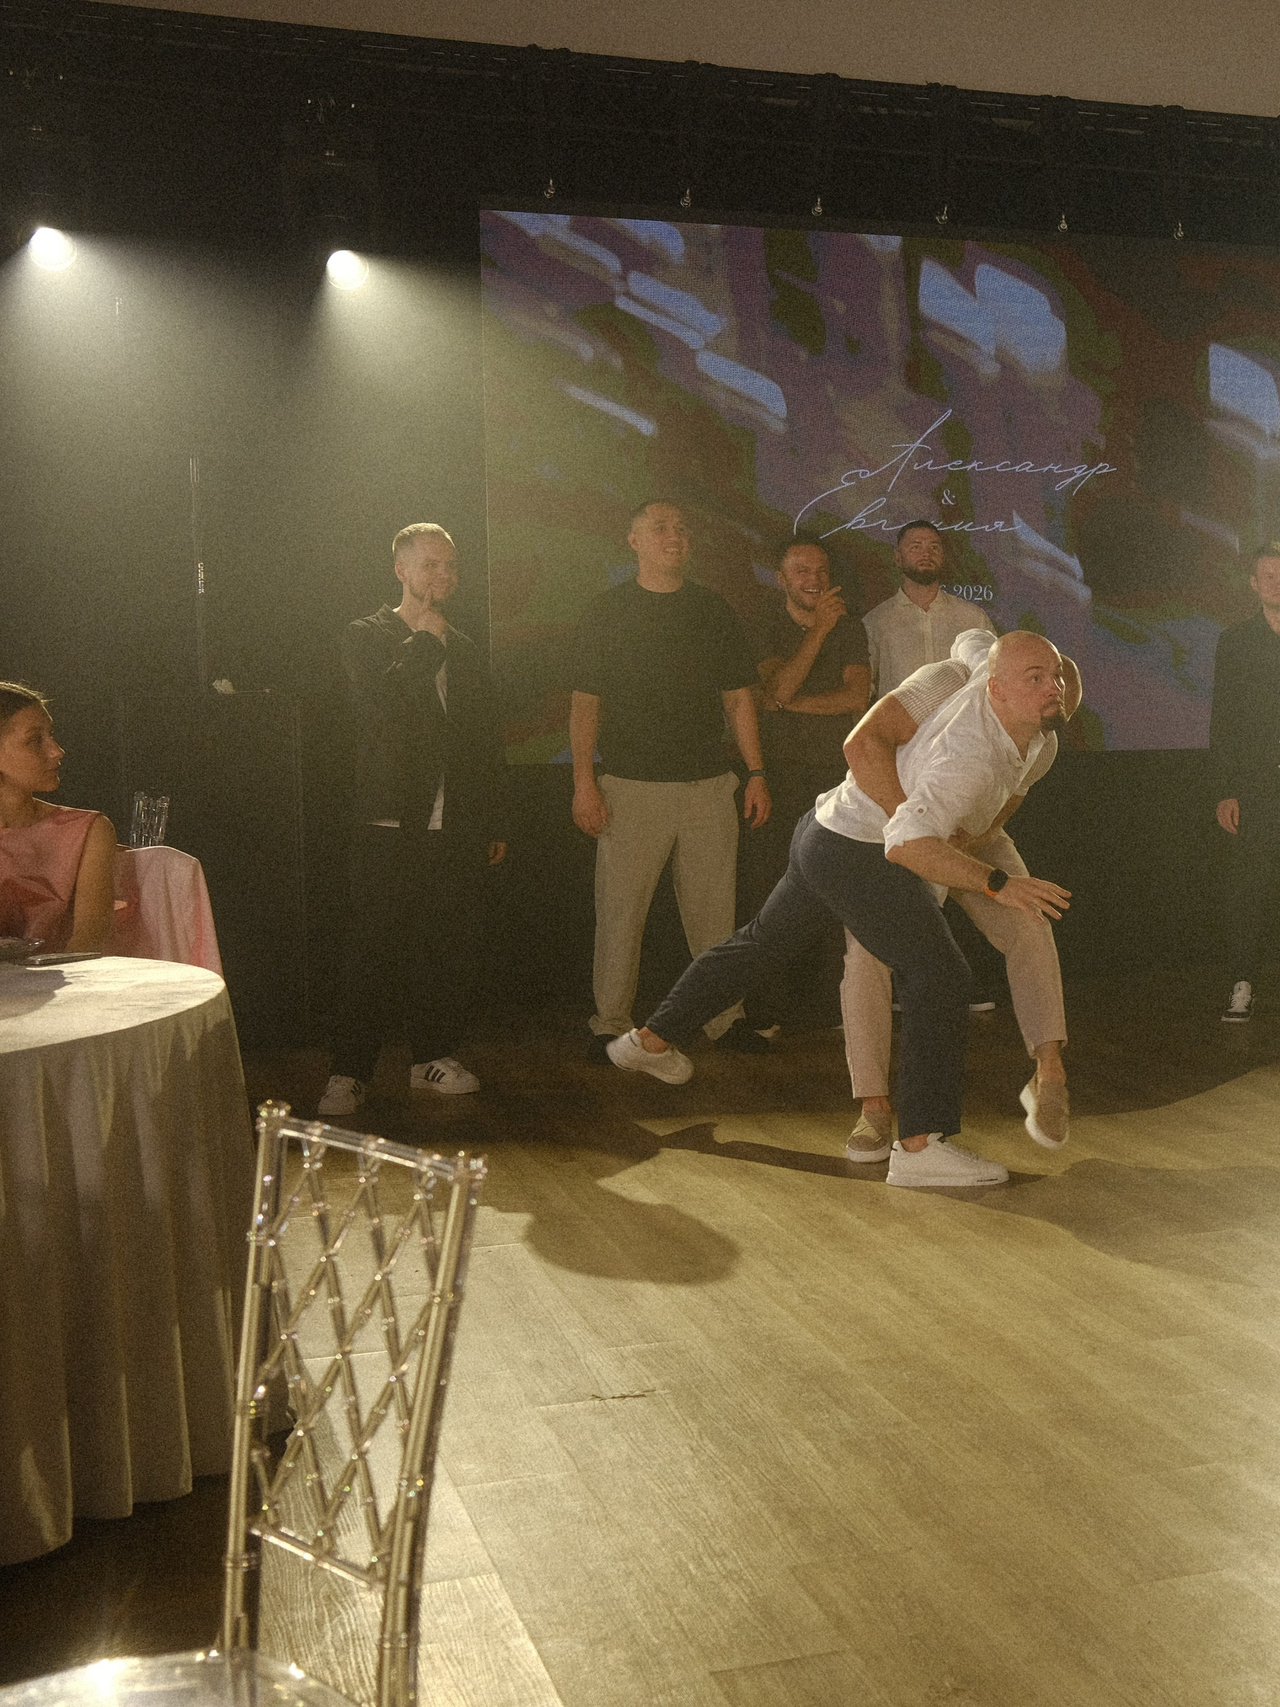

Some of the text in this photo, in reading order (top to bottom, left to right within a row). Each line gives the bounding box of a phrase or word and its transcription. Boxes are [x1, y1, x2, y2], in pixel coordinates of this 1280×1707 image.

[857, 408, 1117, 496] Александр
[793, 468, 1019, 541] Евгния
[941, 489, 956, 505] &
